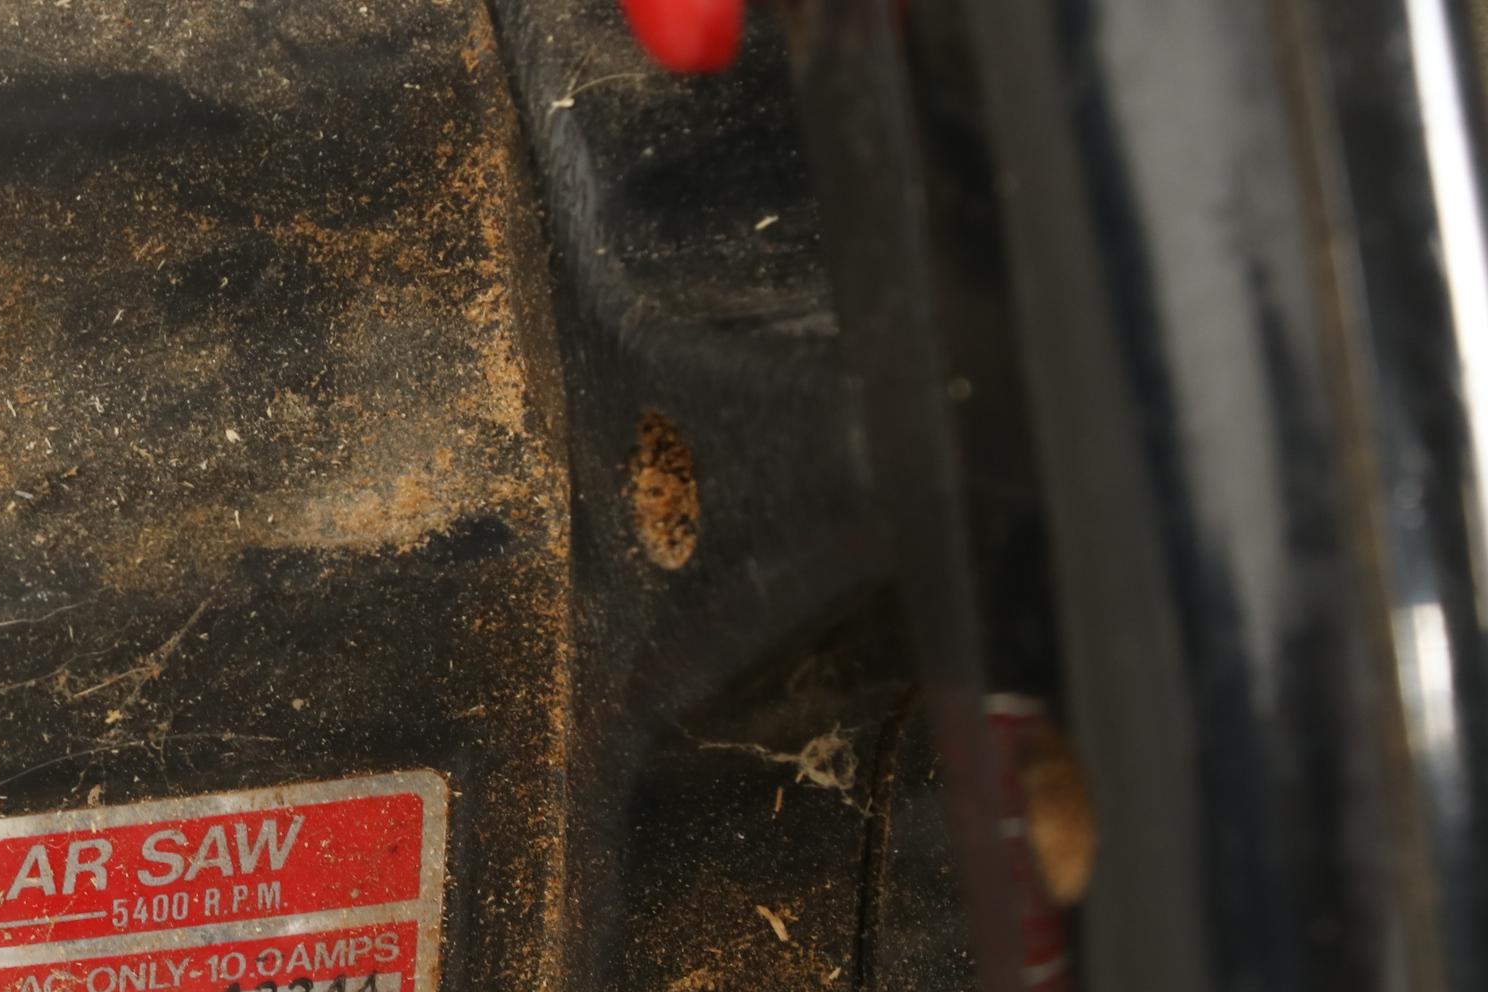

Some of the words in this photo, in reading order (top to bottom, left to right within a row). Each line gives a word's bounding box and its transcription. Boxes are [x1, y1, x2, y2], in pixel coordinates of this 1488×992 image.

[136, 814, 306, 887] SAW
[111, 891, 189, 929] 5400
[203, 880, 289, 917] R.P.M.
